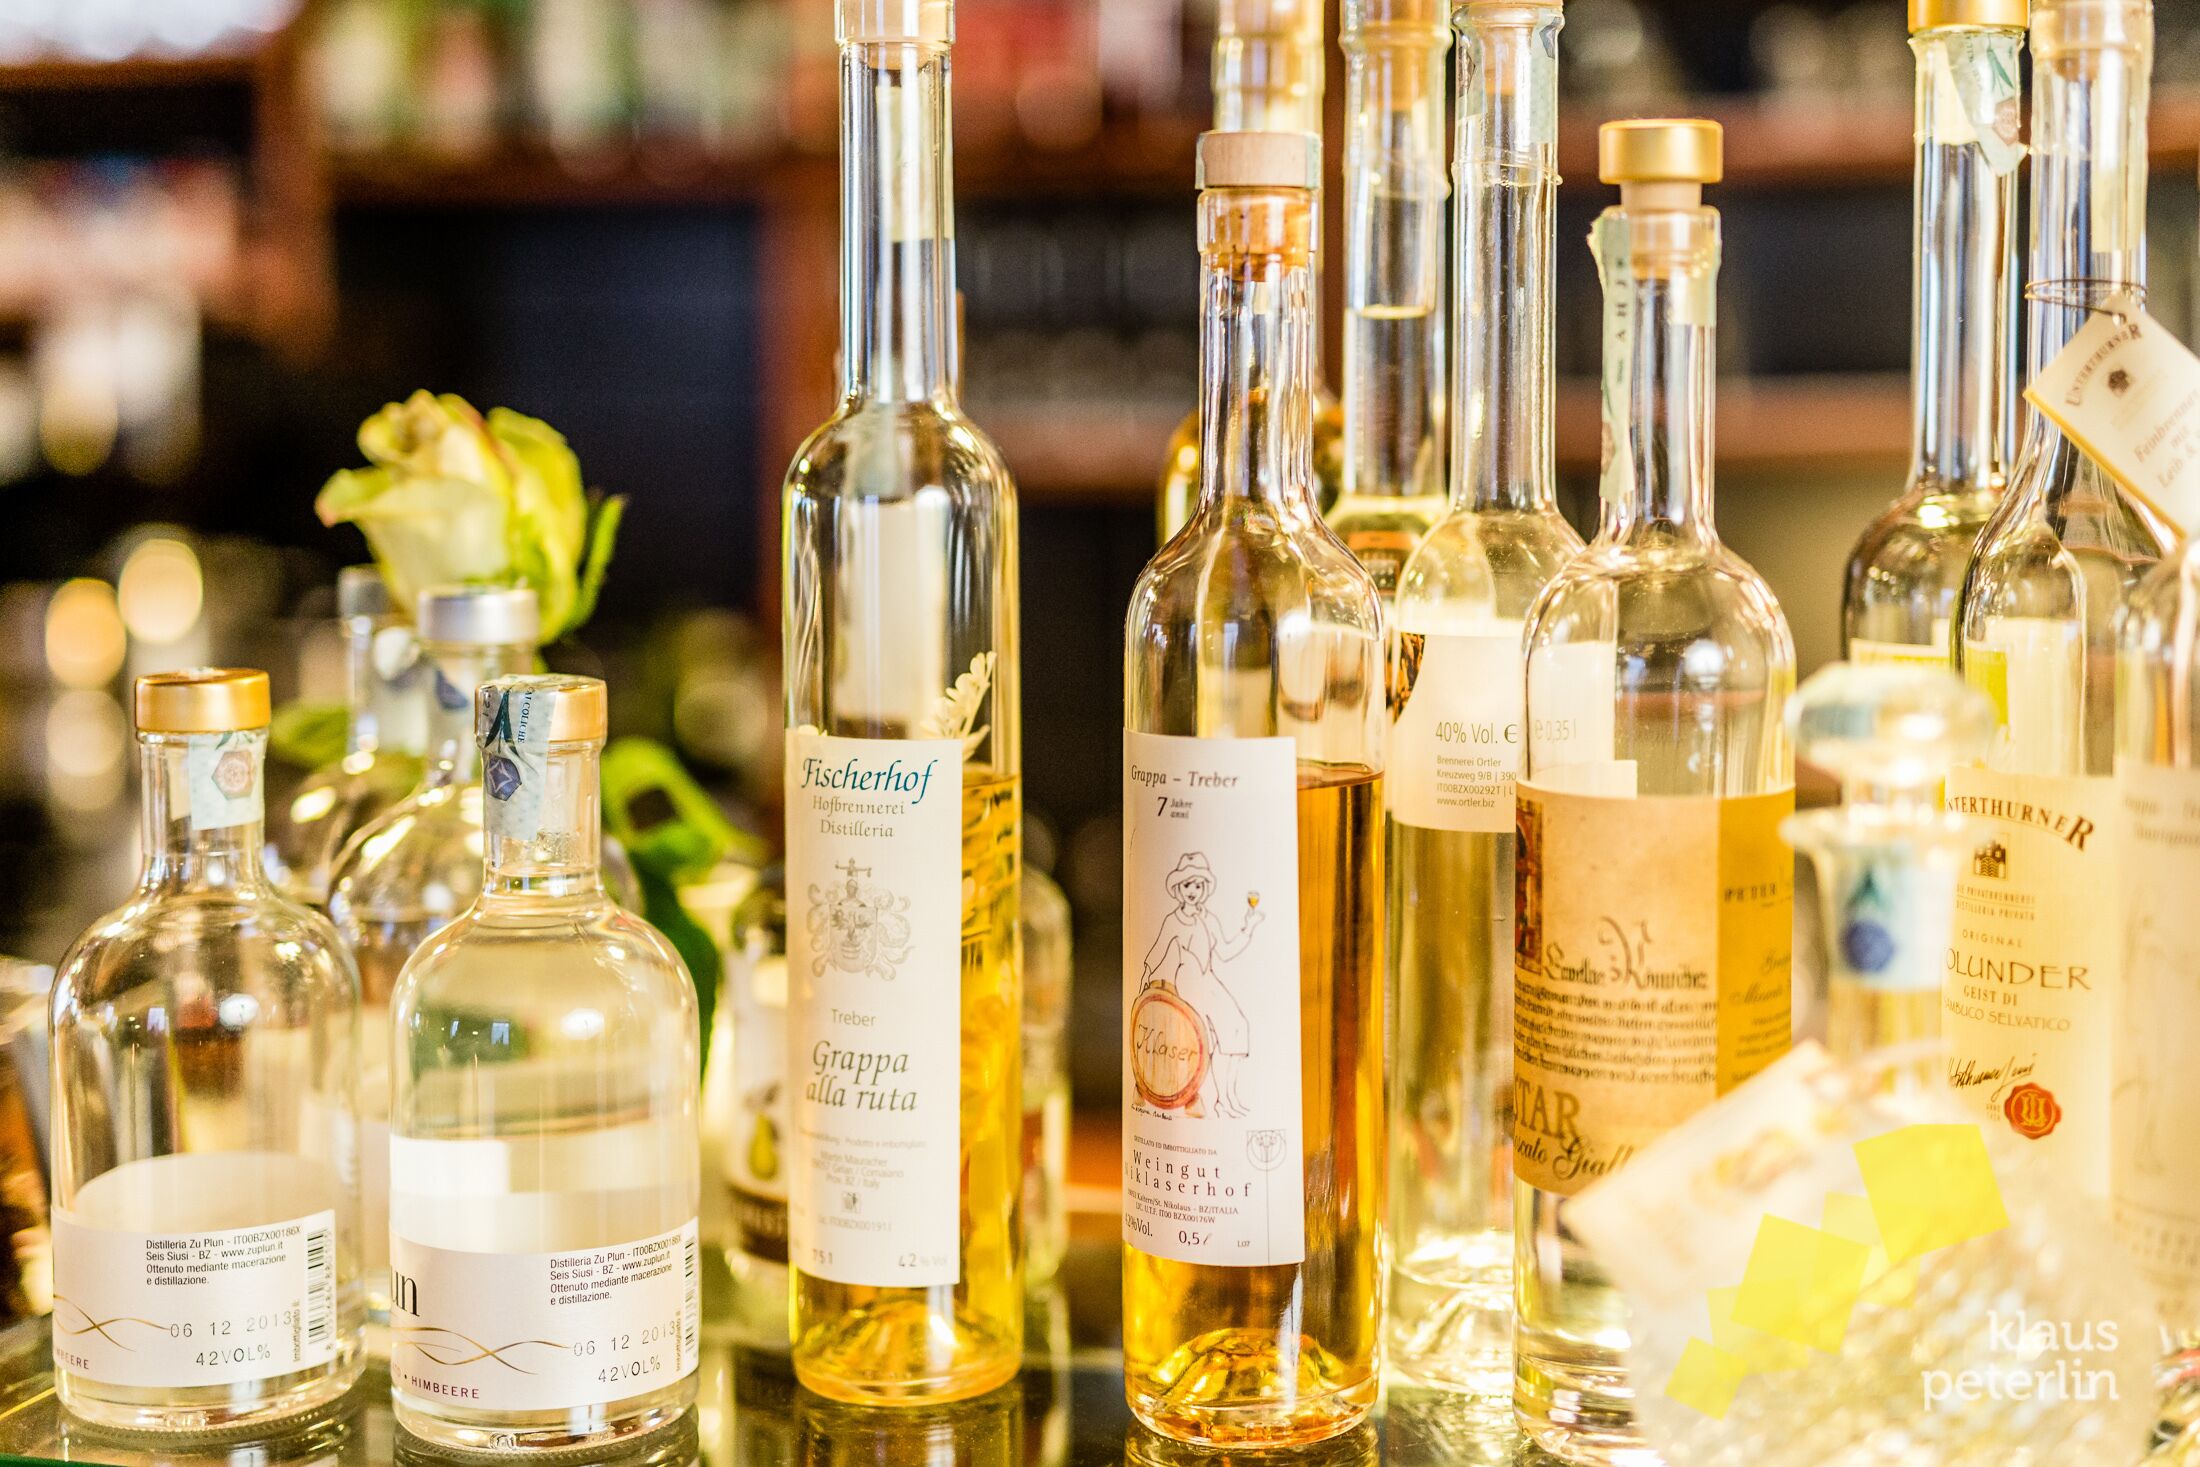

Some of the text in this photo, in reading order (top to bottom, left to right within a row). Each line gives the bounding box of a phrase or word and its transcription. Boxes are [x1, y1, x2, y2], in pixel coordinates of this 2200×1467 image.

[1435, 721, 1467, 744] 40%
[1471, 722, 1498, 744] Vol.
[1436, 755, 1502, 767] Brennerei Ortler
[801, 758, 939, 805] Fischerhof
[1131, 765, 1167, 788] Grappa
[1188, 771, 1239, 789] Treber
[1436, 769, 1476, 781] Kreuzweg
[812, 795, 906, 818] Hofbrennerei
[1157, 796, 1193, 817] 7 Jahre
[1436, 797, 1495, 809] www.ortler.biz
[1170, 810, 1190, 820] anni
[820, 818, 894, 838] Distilleria
[1962, 929, 2022, 948] ORIGINAL
[1963, 984, 2017, 1007] GEIST DI
[831, 1008, 876, 1027] Treber
[1988, 1010, 2072, 1032] SELVATICO
[812, 1040, 910, 1087] Grappa
[805, 1073, 918, 1112] alla ruta
[1514, 1075, 1581, 1139] TAR
[1133, 1149, 1220, 1180] Weingut
[1163, 1200, 1191, 1212] Nikolaus
[1199, 1205, 1239, 1215] BZ/ITALIA
[146, 1239, 187, 1250] Distilleria
[189, 1239, 201, 1249] Zu
[203, 1237, 224, 1248] Plun
[146, 1251, 165, 1261] Seis
[167, 1251, 189, 1261] Siusi
[199, 1250, 211, 1260] BZ
[220, 1241, 284, 1258] www.zuplun.it
[146, 1253, 287, 1274] Ottenuto mediante macerazione
[550, 1256, 592, 1269] Distilleria
[594, 1254, 605, 1265] Zu
[607, 1251, 625, 1262] Plun
[550, 1270, 570, 1281] Seis
[572, 1268, 593, 1279] Siusi
[602, 1264, 614, 1275] BZ
[622, 1250, 671, 1271] www.zuplun.it
[146, 1274, 210, 1286] e distillazione.
[550, 1263, 673, 1294] Ottenuto mediante macerazione
[550, 1290, 612, 1306] e distillazione.
[170, 1310, 293, 1339] 06 12 2013
[573, 1320, 676, 1357] 06 12 2013
[195, 1345, 271, 1367] 42VOL%
[597, 1354, 661, 1384] 42VOL%
[411, 1375, 480, 1399] HIMBEERE
